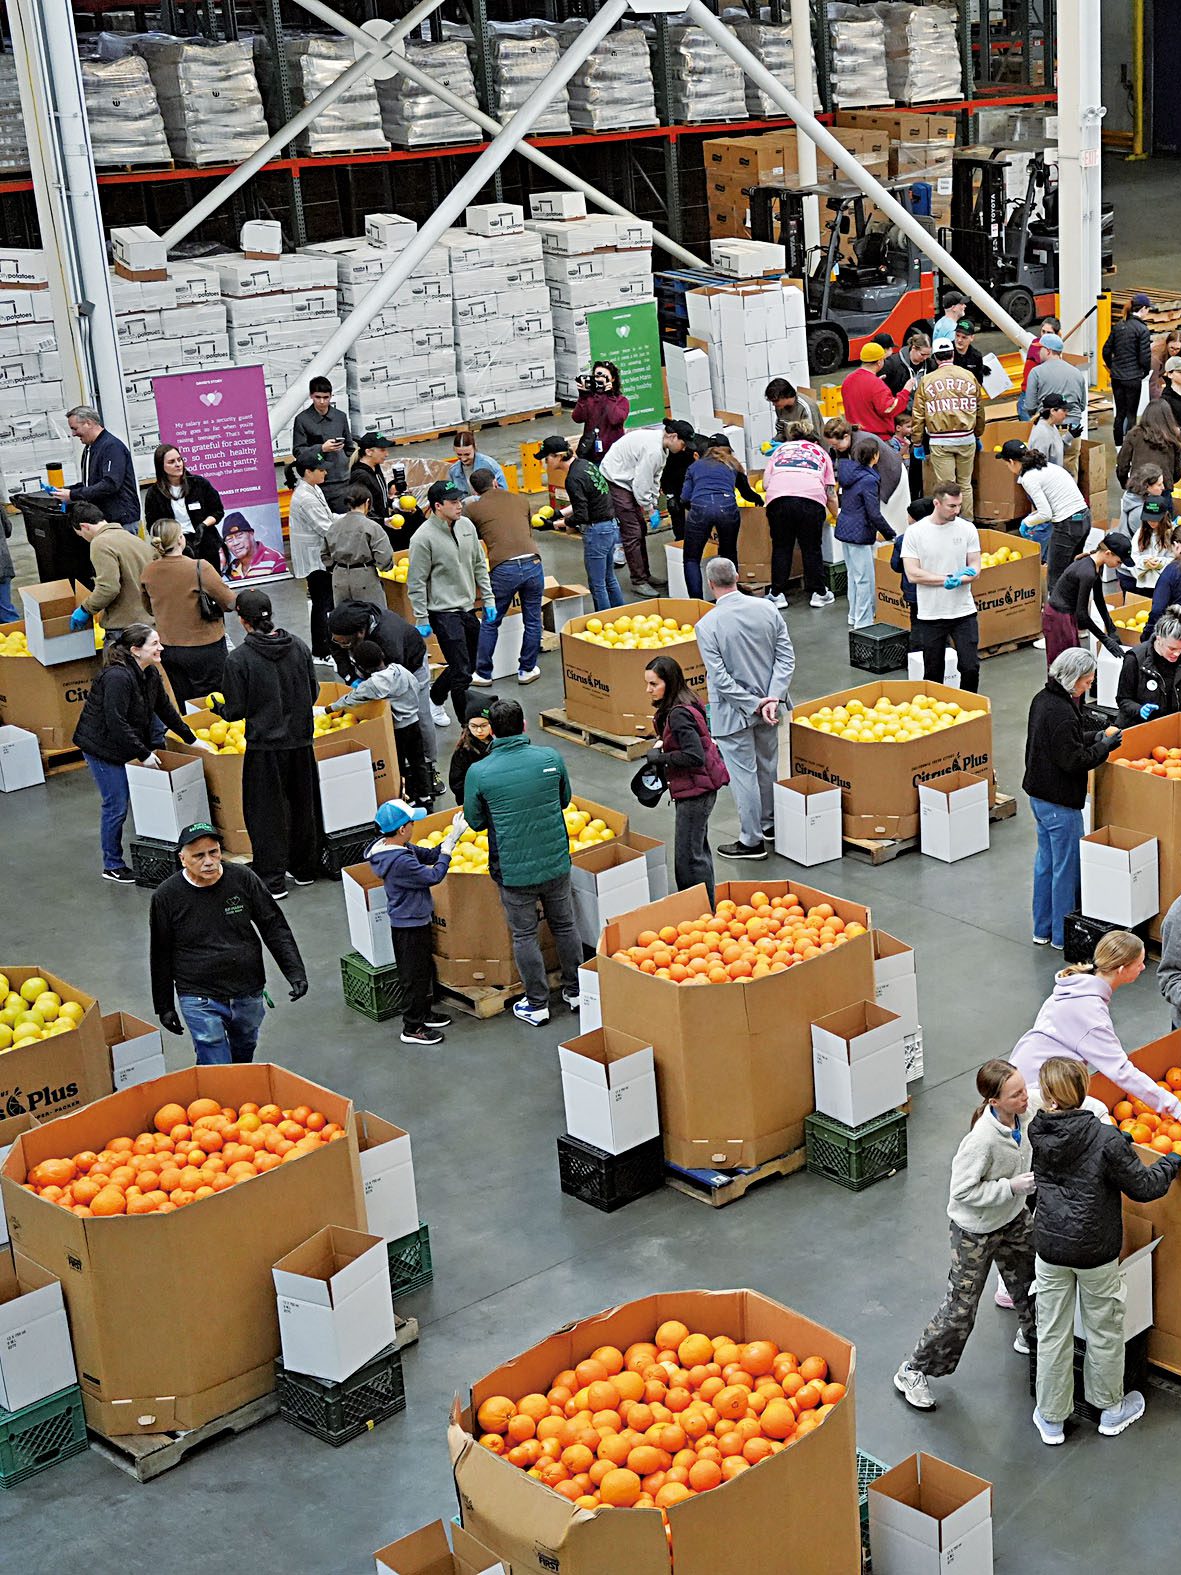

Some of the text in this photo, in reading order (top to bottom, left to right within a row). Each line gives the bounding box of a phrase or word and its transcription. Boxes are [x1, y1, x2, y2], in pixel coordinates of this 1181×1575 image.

[924, 378, 977, 397] FORTY
[925, 397, 977, 413] NINERS
[178, 438, 256, 453] I'm grateful for access
[204, 450, 225, 460] much
[230, 447, 257, 457] healthy
[199, 461, 218, 471] from
[219, 459, 231, 468] the
[233, 457, 258, 467] pantry.
[878, 592, 900, 606] Citrus
[1014, 588, 1036, 602] Plus
[567, 669, 610, 693] Citrus Plus
[65, 688, 89, 703] Cit
[963, 753, 988, 772] Plus
[830, 773, 852, 790] Plus
[27, 1082, 79, 1109] Plus
[538, 1555, 560, 1572] FIRST
